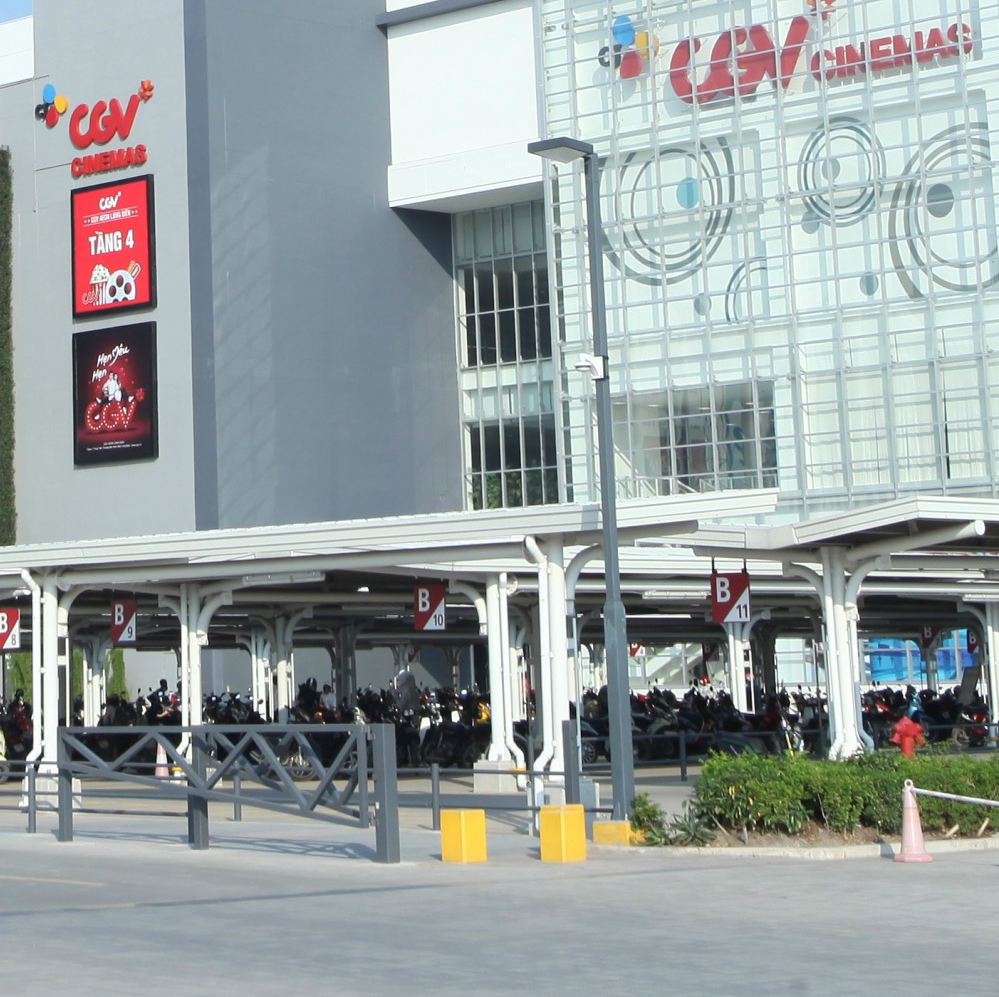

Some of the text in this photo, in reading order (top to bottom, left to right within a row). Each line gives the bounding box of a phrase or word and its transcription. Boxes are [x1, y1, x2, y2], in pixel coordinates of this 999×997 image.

[669, 15, 973, 104] CGV CINEMAS
[69, 94, 140, 149] CGV
[71, 144, 148, 178] CINEMAS
[99, 193, 119, 210] CGV
[125, 229, 134, 249] 4
[418, 588, 430, 612] B
[716, 576, 731, 603] B
[115, 603, 125, 625] B
[433, 614, 443, 626] 10
[736, 604, 748, 619] 11
[11, 634, 17, 646] 8
[128, 626, 133, 639] 9
